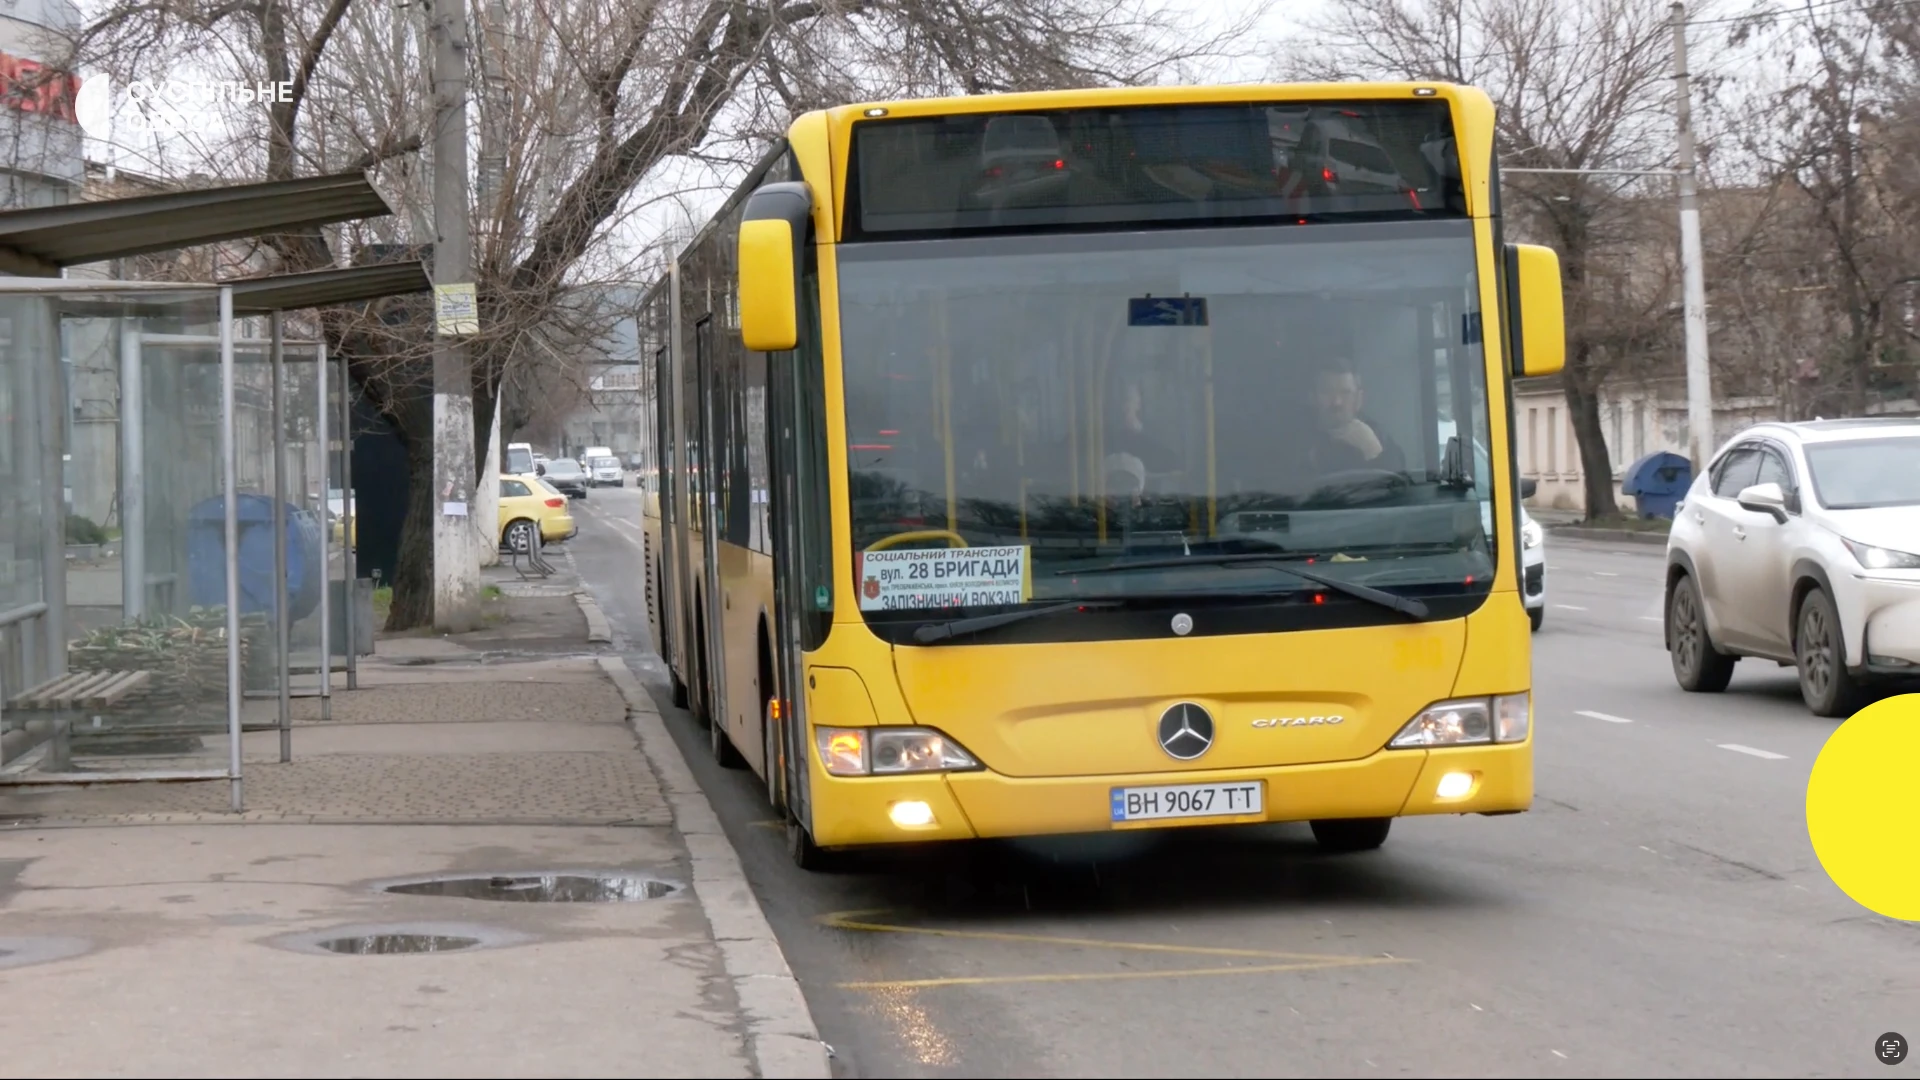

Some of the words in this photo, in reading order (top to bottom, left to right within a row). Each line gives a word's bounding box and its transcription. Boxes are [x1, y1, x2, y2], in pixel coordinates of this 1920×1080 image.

[866, 550, 946, 562] СОЦІАЛЬНИЙ
[951, 547, 1021, 559] ТРАНСПОРТ
[881, 568, 904, 584] вул.
[909, 562, 929, 579] 28
[934, 559, 1019, 578] БРИГАДИ
[1251, 715, 1344, 728] CITARO
[1165, 789, 1215, 812] 9067
